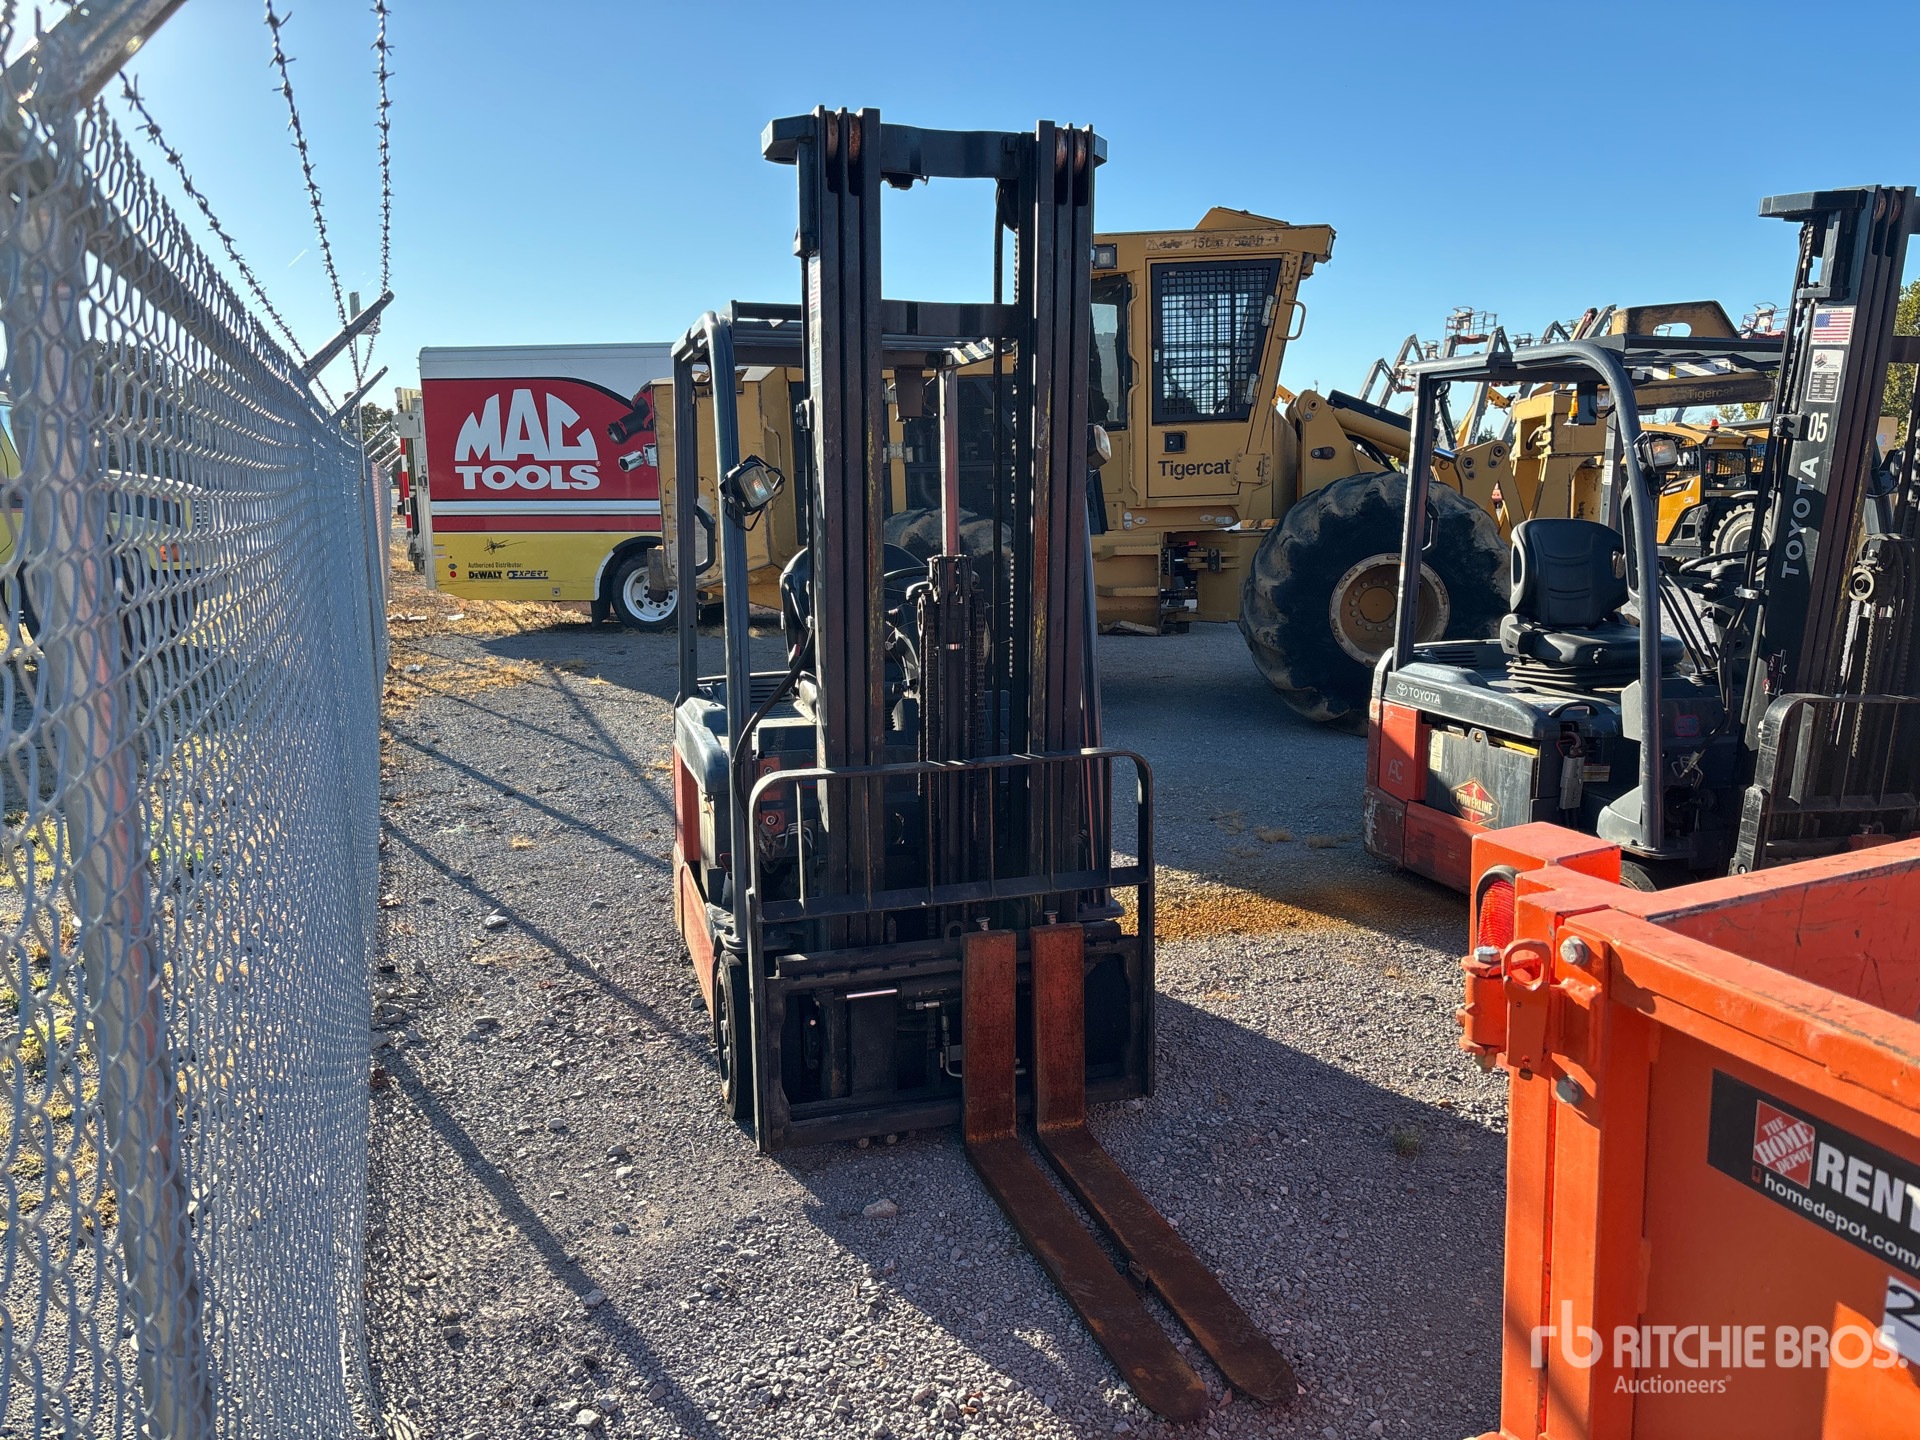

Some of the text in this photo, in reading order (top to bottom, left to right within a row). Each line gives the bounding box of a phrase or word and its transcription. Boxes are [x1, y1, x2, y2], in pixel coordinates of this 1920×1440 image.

[455, 389, 599, 461] MAC
[1807, 412, 1829, 442] 05
[455, 465, 600, 490] TOOLS
[1158, 459, 1231, 480] Tigercat
[1781, 456, 1820, 579] TOYOTA
[1408, 687, 1441, 705] TOYOTA
[1456, 791, 1494, 816] POWERLINE
[1761, 1116, 1787, 1136] THE
[1754, 1121, 1815, 1166] HOME
[1775, 1146, 1812, 1175] DEPOT
